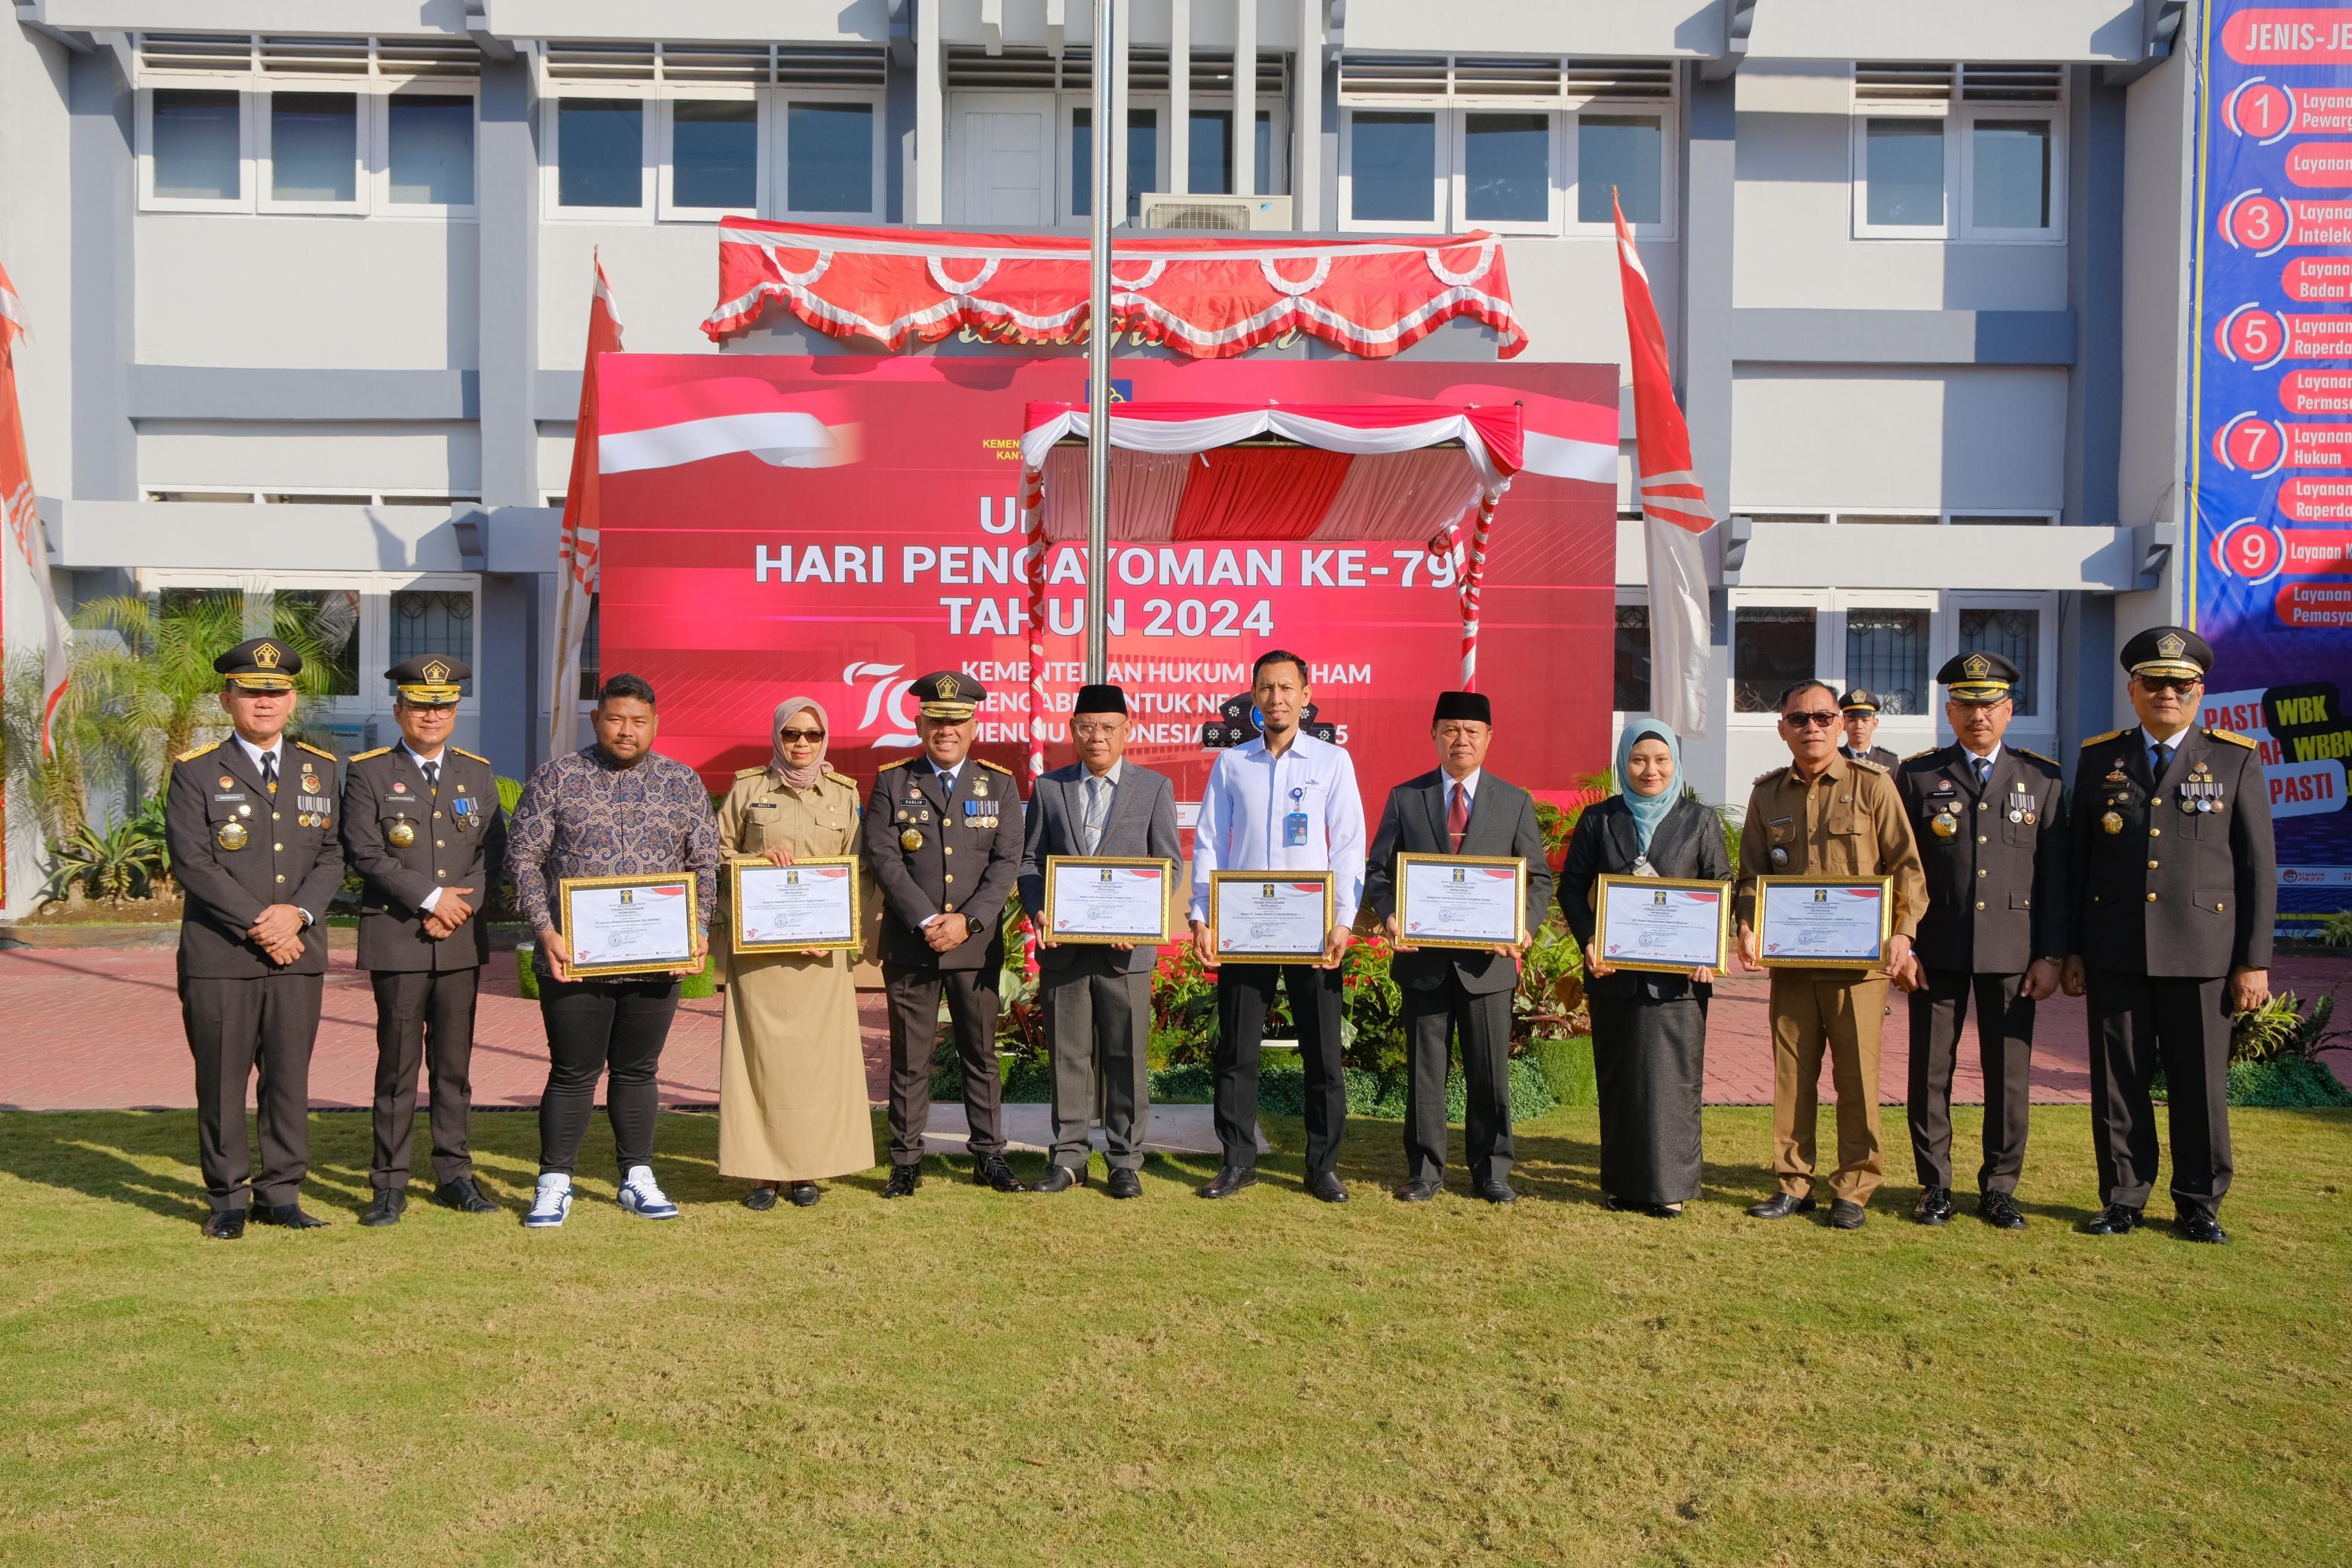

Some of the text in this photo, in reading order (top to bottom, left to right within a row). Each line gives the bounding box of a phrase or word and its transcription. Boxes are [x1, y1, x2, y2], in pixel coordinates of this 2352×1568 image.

[2245, 23, 2352, 51] JENIS-JE
[2254, 93, 2268, 128] 1
[2247, 206, 2270, 240] 3
[2301, 261, 2352, 280] Layana
[2300, 282, 2344, 297] Badan
[2244, 320, 2268, 354] 5
[2294, 339, 2352, 358] Raperda
[2243, 428, 2267, 462] 7
[2295, 449, 2341, 464] Hukum
[2296, 502, 2352, 520] Raperda
[2242, 534, 2266, 569] 9
[2291, 542, 2341, 563] Layanan
[755, 545, 884, 583] HARI
[1300, 549, 1456, 588] KE-79
[2294, 586, 2351, 605] Layanan
[1142, 598, 1274, 637] 2024
[1149, 663, 1245, 683] HUKUM
[1311, 663, 1370, 684] HAM
[2203, 702, 2268, 731] PASTI
[2275, 695, 2329, 726] WBK
[2269, 772, 2334, 804] PASTI
